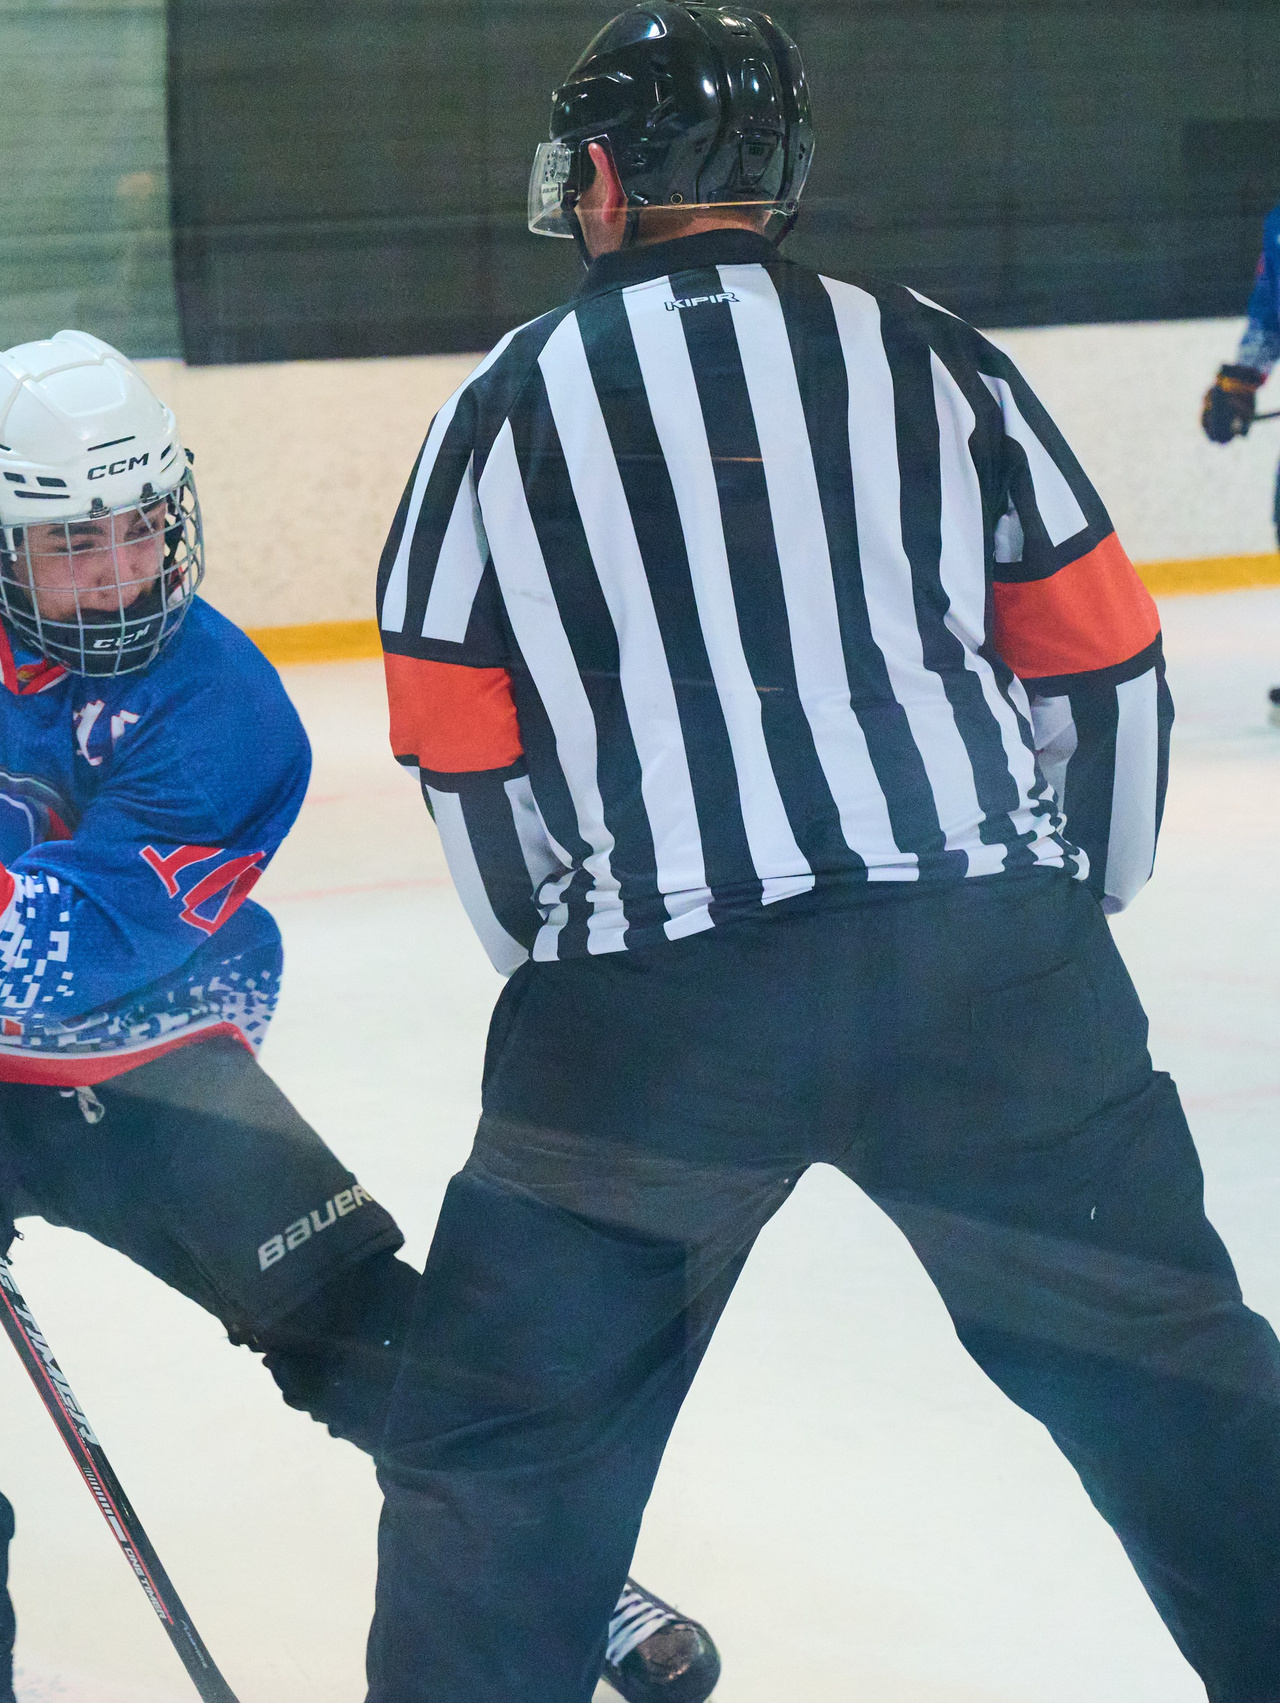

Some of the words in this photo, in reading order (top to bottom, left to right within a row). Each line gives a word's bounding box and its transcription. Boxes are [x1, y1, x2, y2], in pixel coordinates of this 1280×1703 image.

[664, 291, 741, 312] KIPIR
[87, 453, 150, 481] CCM
[93, 624, 151, 649] CCM
[124, 1547, 146, 1577] ONE
[140, 1578, 167, 1620] TIMER
